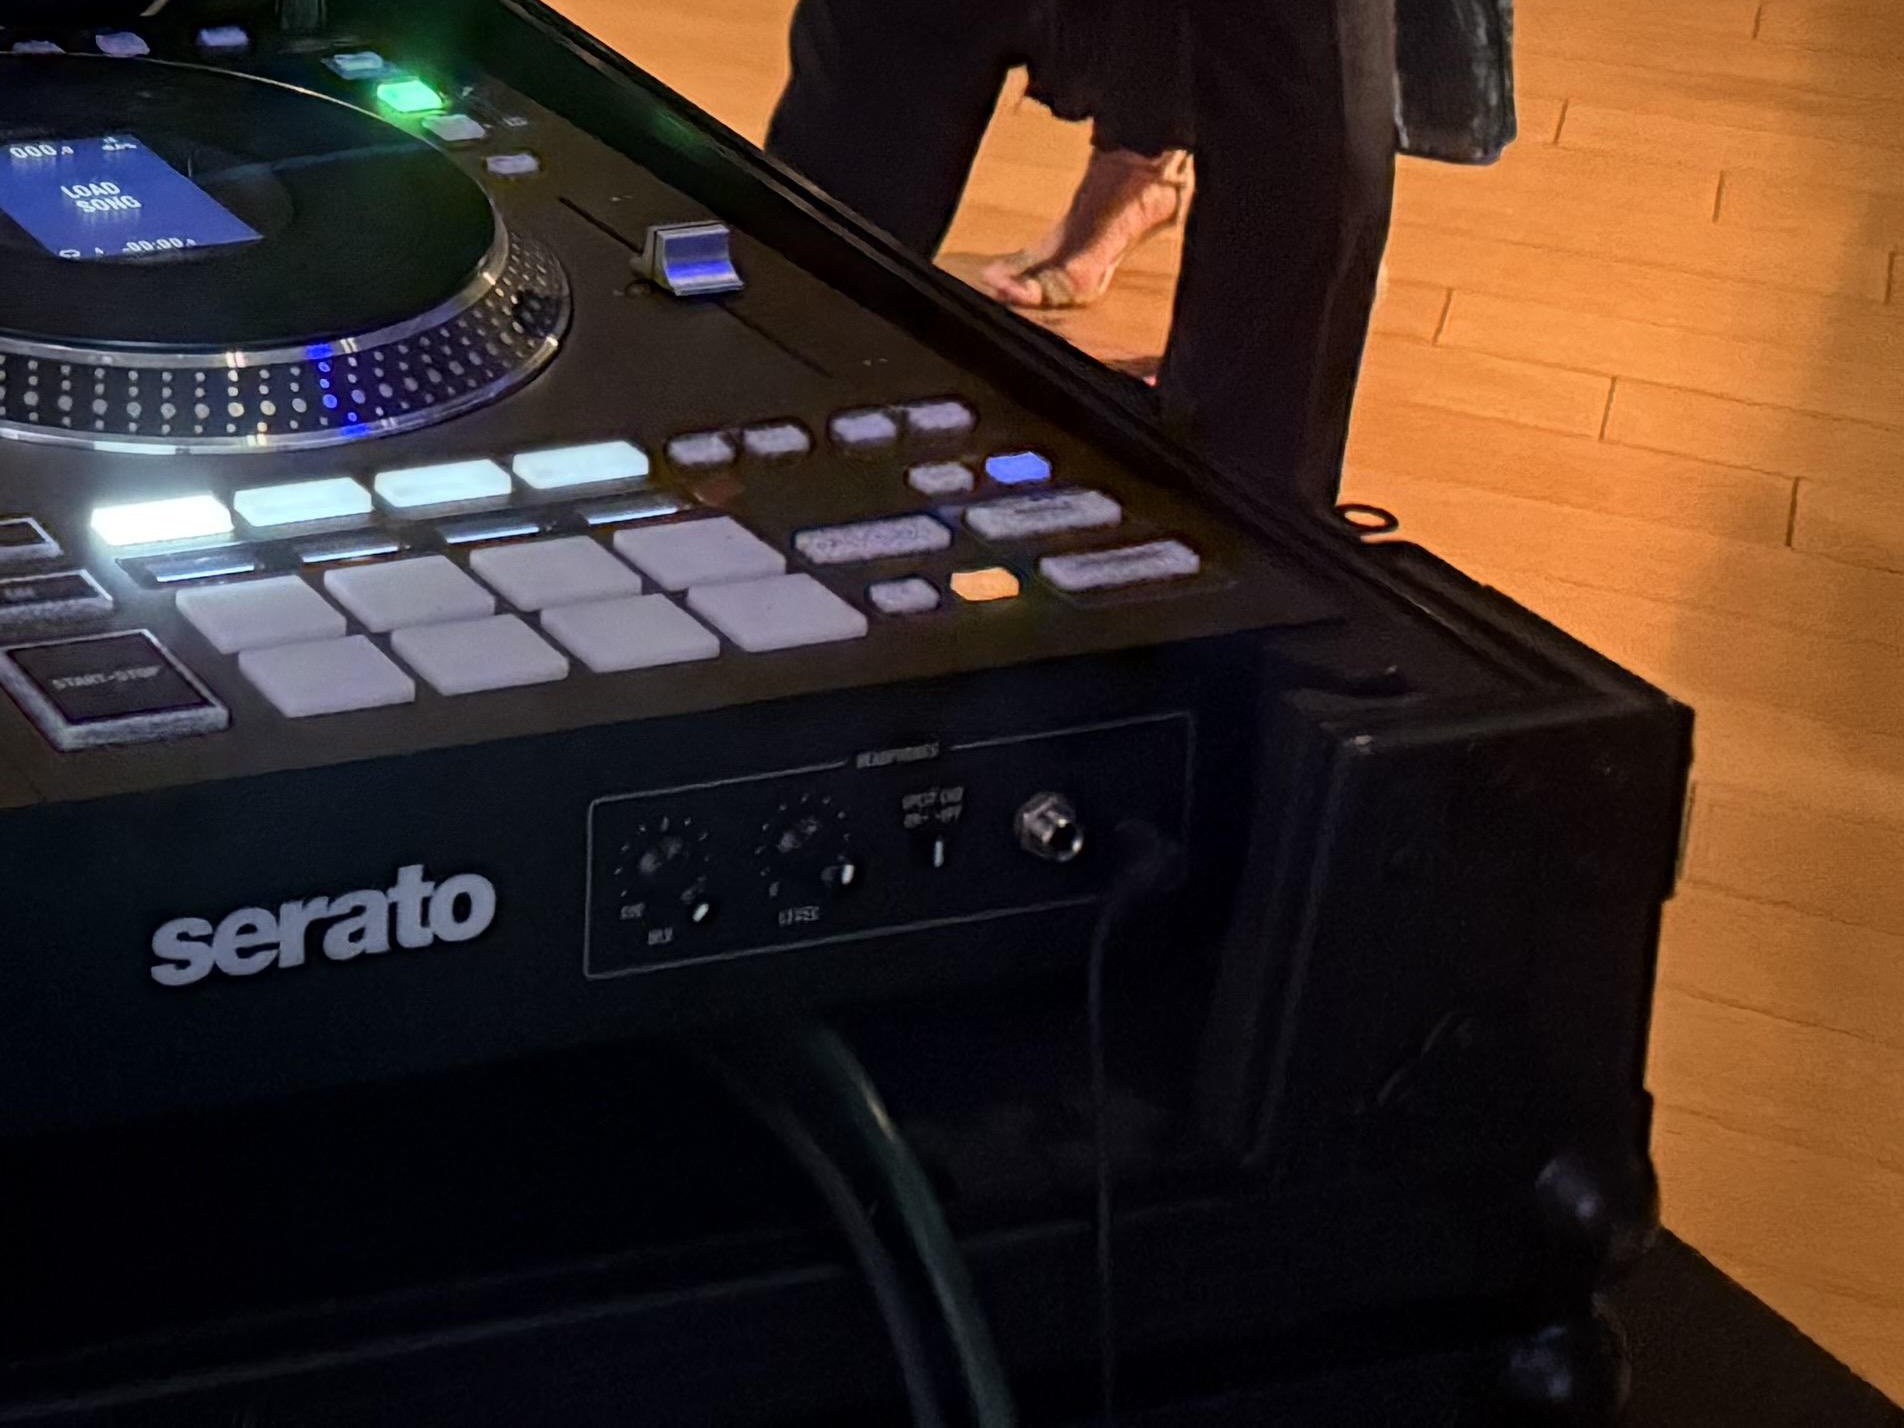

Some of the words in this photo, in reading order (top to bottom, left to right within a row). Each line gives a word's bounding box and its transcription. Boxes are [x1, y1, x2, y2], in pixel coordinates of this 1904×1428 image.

[61, 181, 121, 199] LOAD
[76, 196, 142, 214] SONG
[150, 864, 496, 986] serato
